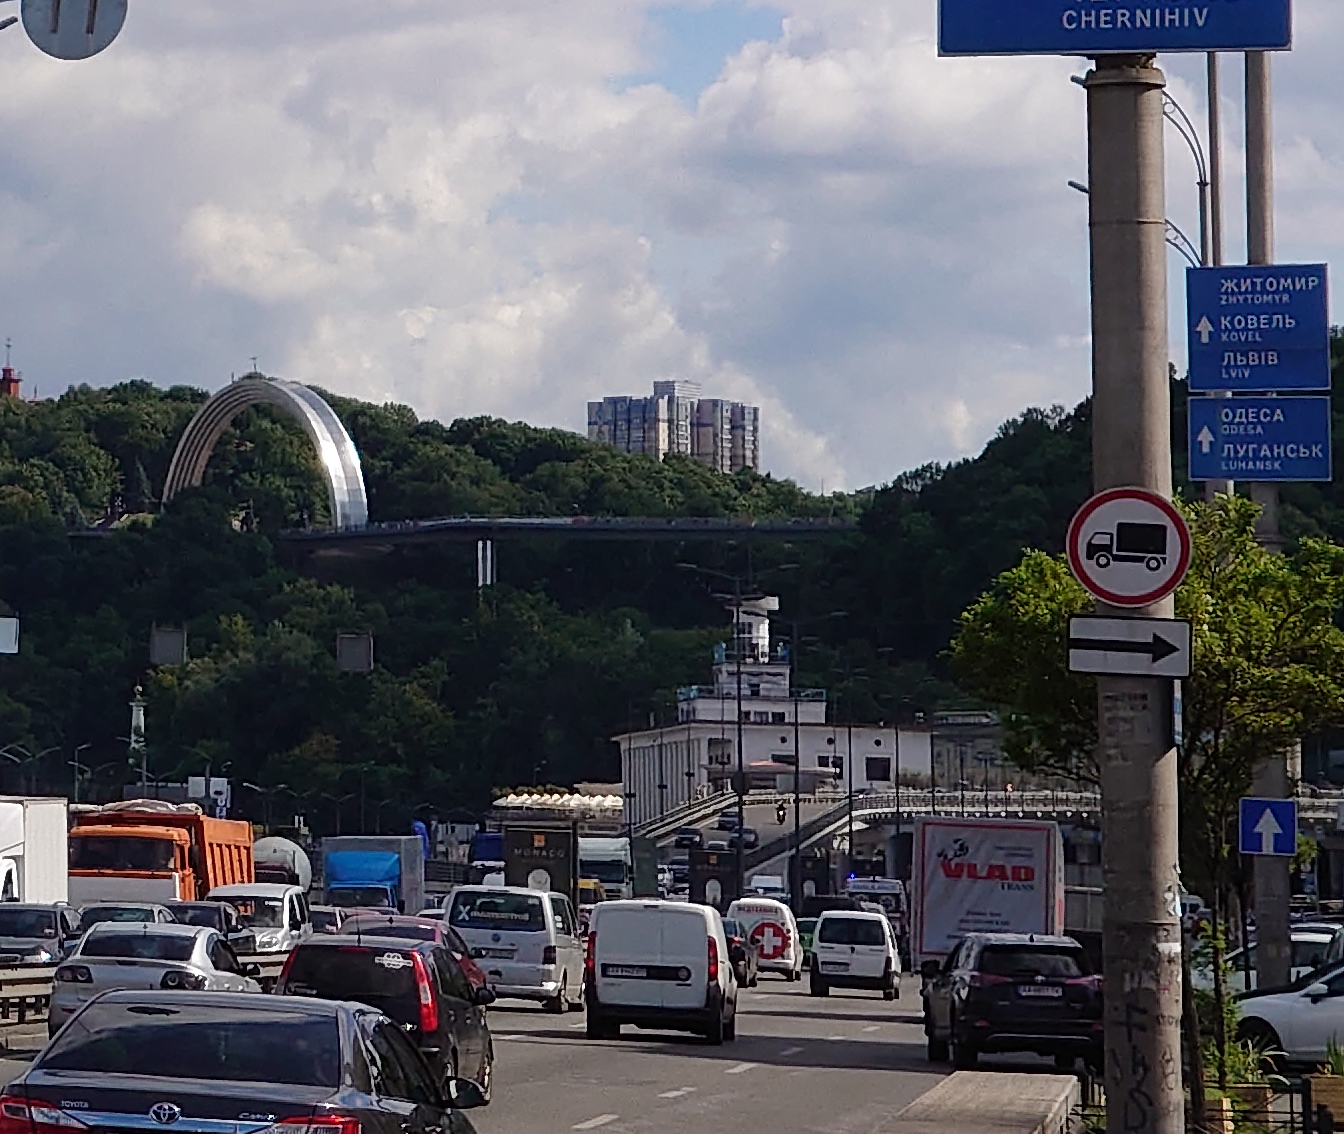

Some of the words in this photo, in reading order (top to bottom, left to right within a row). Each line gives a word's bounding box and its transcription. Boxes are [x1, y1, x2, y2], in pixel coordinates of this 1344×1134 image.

[1062, 7, 1208, 29] CHERNIHIV
[1220, 276, 1319, 292] ЖИТОМИР
[1220, 295, 1290, 305] ZHYTOMYR
[1220, 314, 1296, 330] КОВЕЛЬ
[1221, 332, 1262, 342] KOVEL
[1222, 351, 1278, 366] ЛЬВІВ
[1222, 369, 1250, 378] LVIV
[1221, 408, 1285, 424] ОДЕСА
[1221, 424, 1263, 434] ODESA
[1221, 443, 1323, 458] ЛУГАНСЬК
[1222, 460, 1281, 471] LUHANSK
[940, 859, 1035, 882] VLAD
[1001, 881, 1035, 891] TRANS
[61, 1100, 89, 1108] TOYOTA
